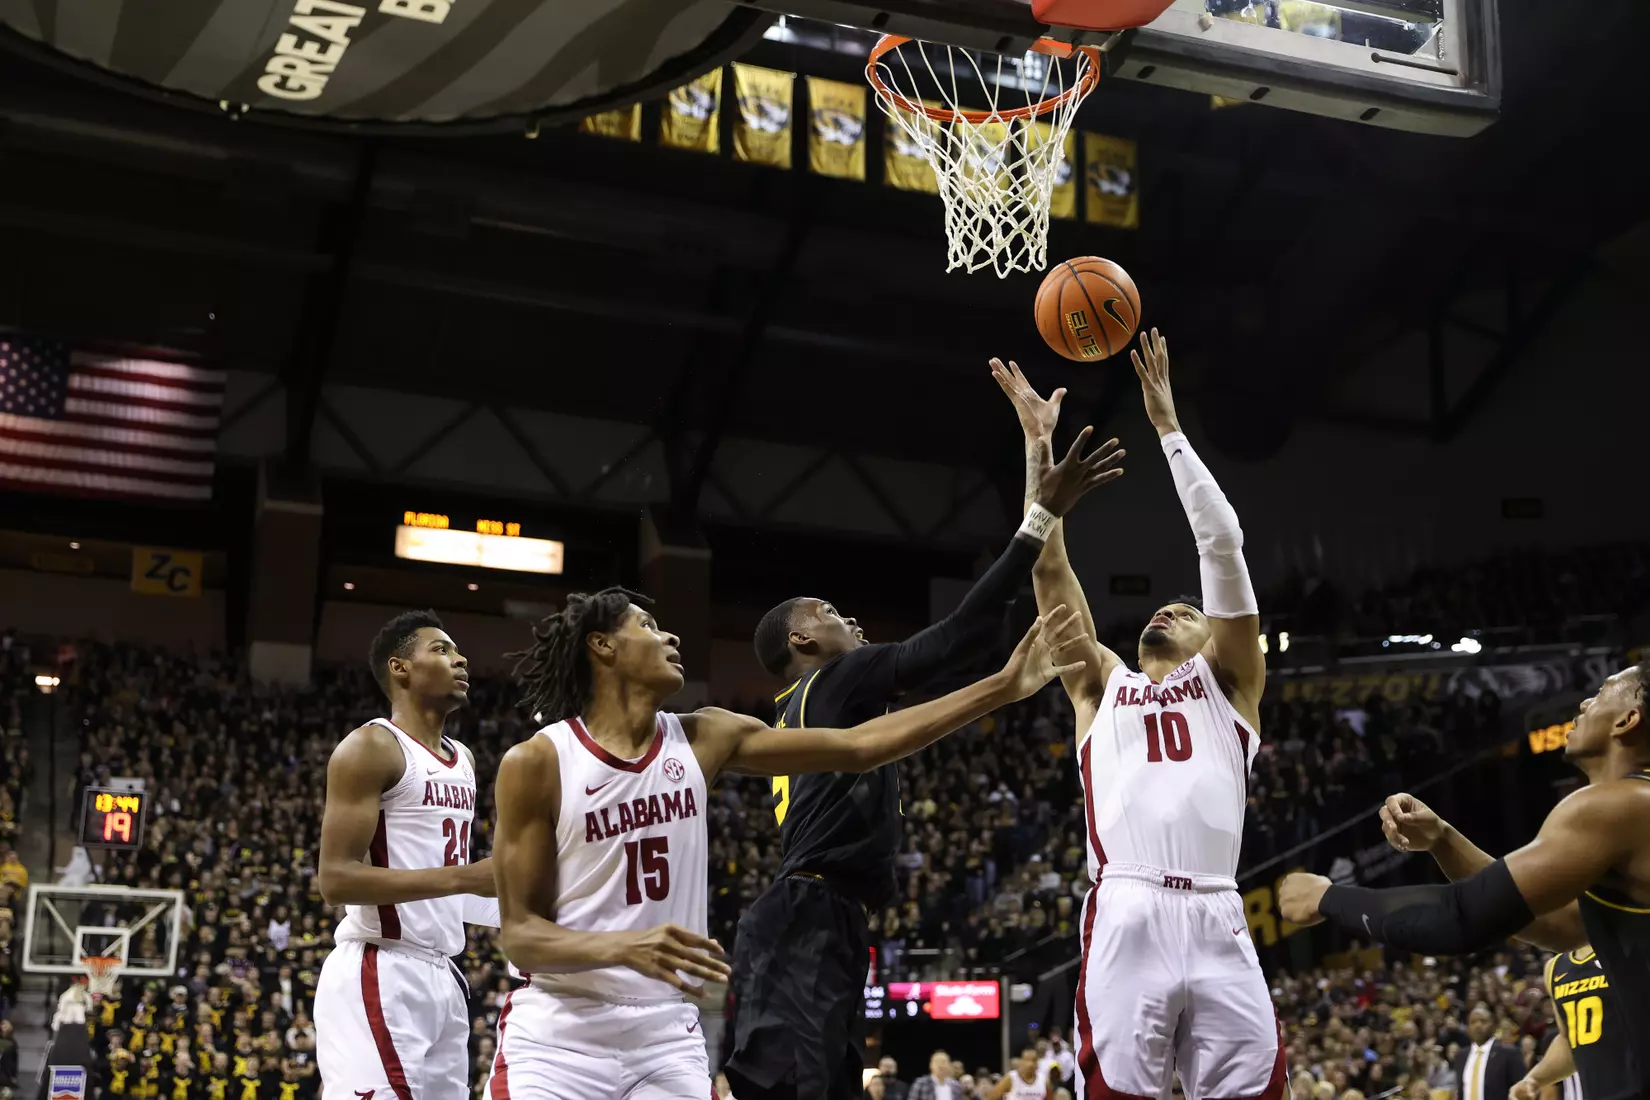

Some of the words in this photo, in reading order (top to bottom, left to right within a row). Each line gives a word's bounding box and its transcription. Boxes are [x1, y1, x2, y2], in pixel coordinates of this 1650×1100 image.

[257, 0, 366, 100] GREAT
[1069, 309, 1103, 358] ELITE
[404, 511, 449, 529] FLORIDA
[1029, 509, 1054, 526] HAVE
[1144, 711, 1192, 762] 10
[664, 758, 685, 782] SEC
[104, 811, 132, 843] 19
[585, 787, 697, 843] ALABAMA
[442, 817, 469, 867] 24
[624, 836, 670, 905] 15
[1163, 875, 1192, 890] RTR
[1562, 995, 1603, 1049] 10
